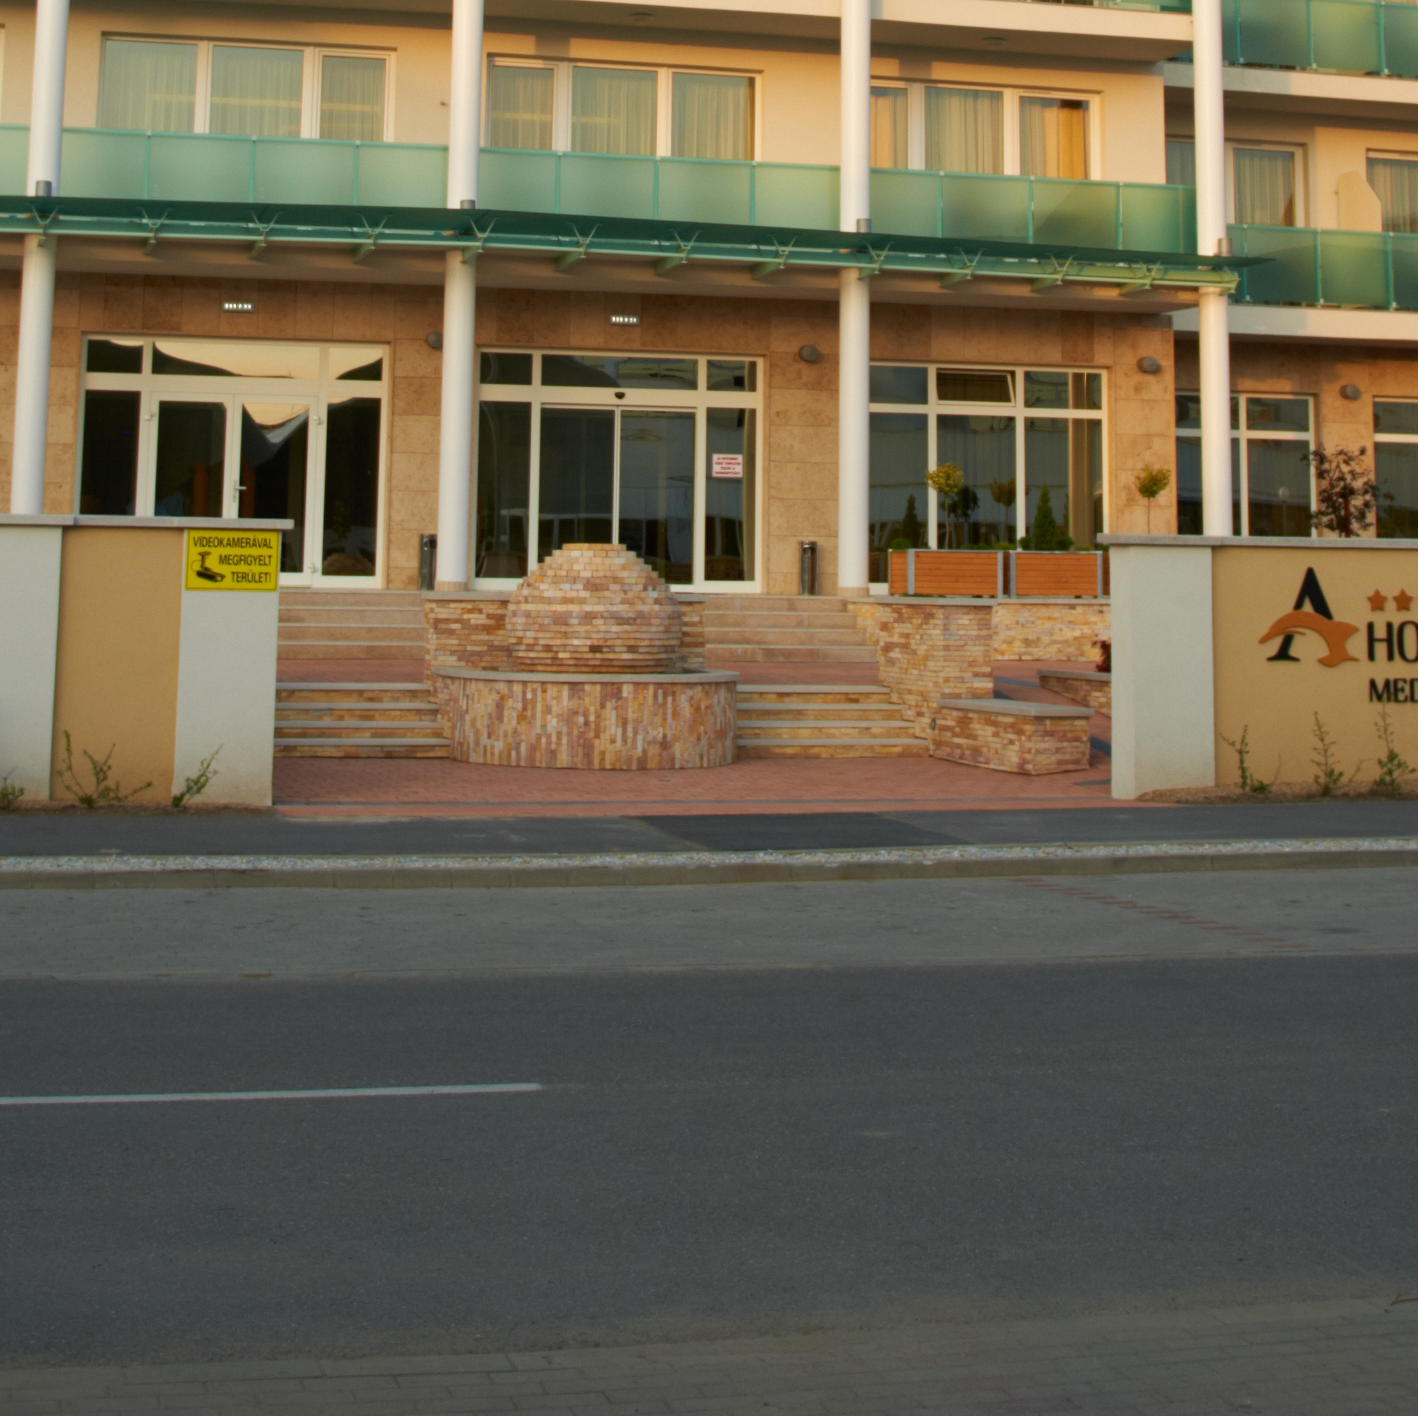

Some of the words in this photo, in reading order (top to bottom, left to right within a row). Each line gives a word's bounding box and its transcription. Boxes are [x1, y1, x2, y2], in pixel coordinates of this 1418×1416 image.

[193, 535, 273, 549] VIDEOKAMERÁVAL
[218, 554, 273, 567] MEGFIGYELT
[230, 569, 271, 583] TERÜLET!
